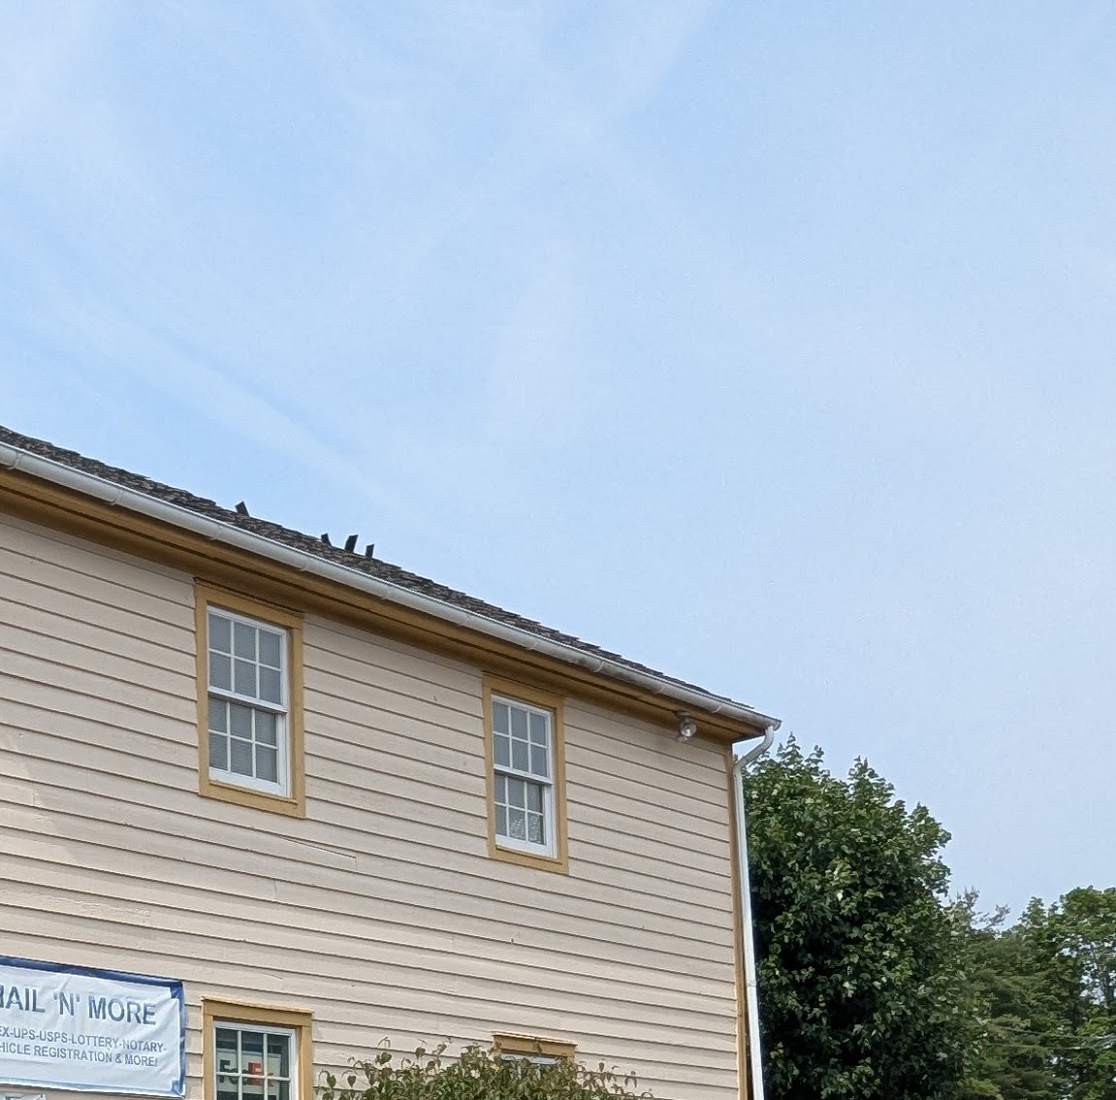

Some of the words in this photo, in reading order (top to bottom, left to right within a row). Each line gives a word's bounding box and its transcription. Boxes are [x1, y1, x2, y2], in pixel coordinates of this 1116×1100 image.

[53, 991, 80, 1016] 'N'
[88, 995, 156, 1025] MORE
[33, 1045, 112, 1064] REGISTRATION
[115, 1055, 122, 1064] &
[124, 1055, 158, 1067] MORE!
